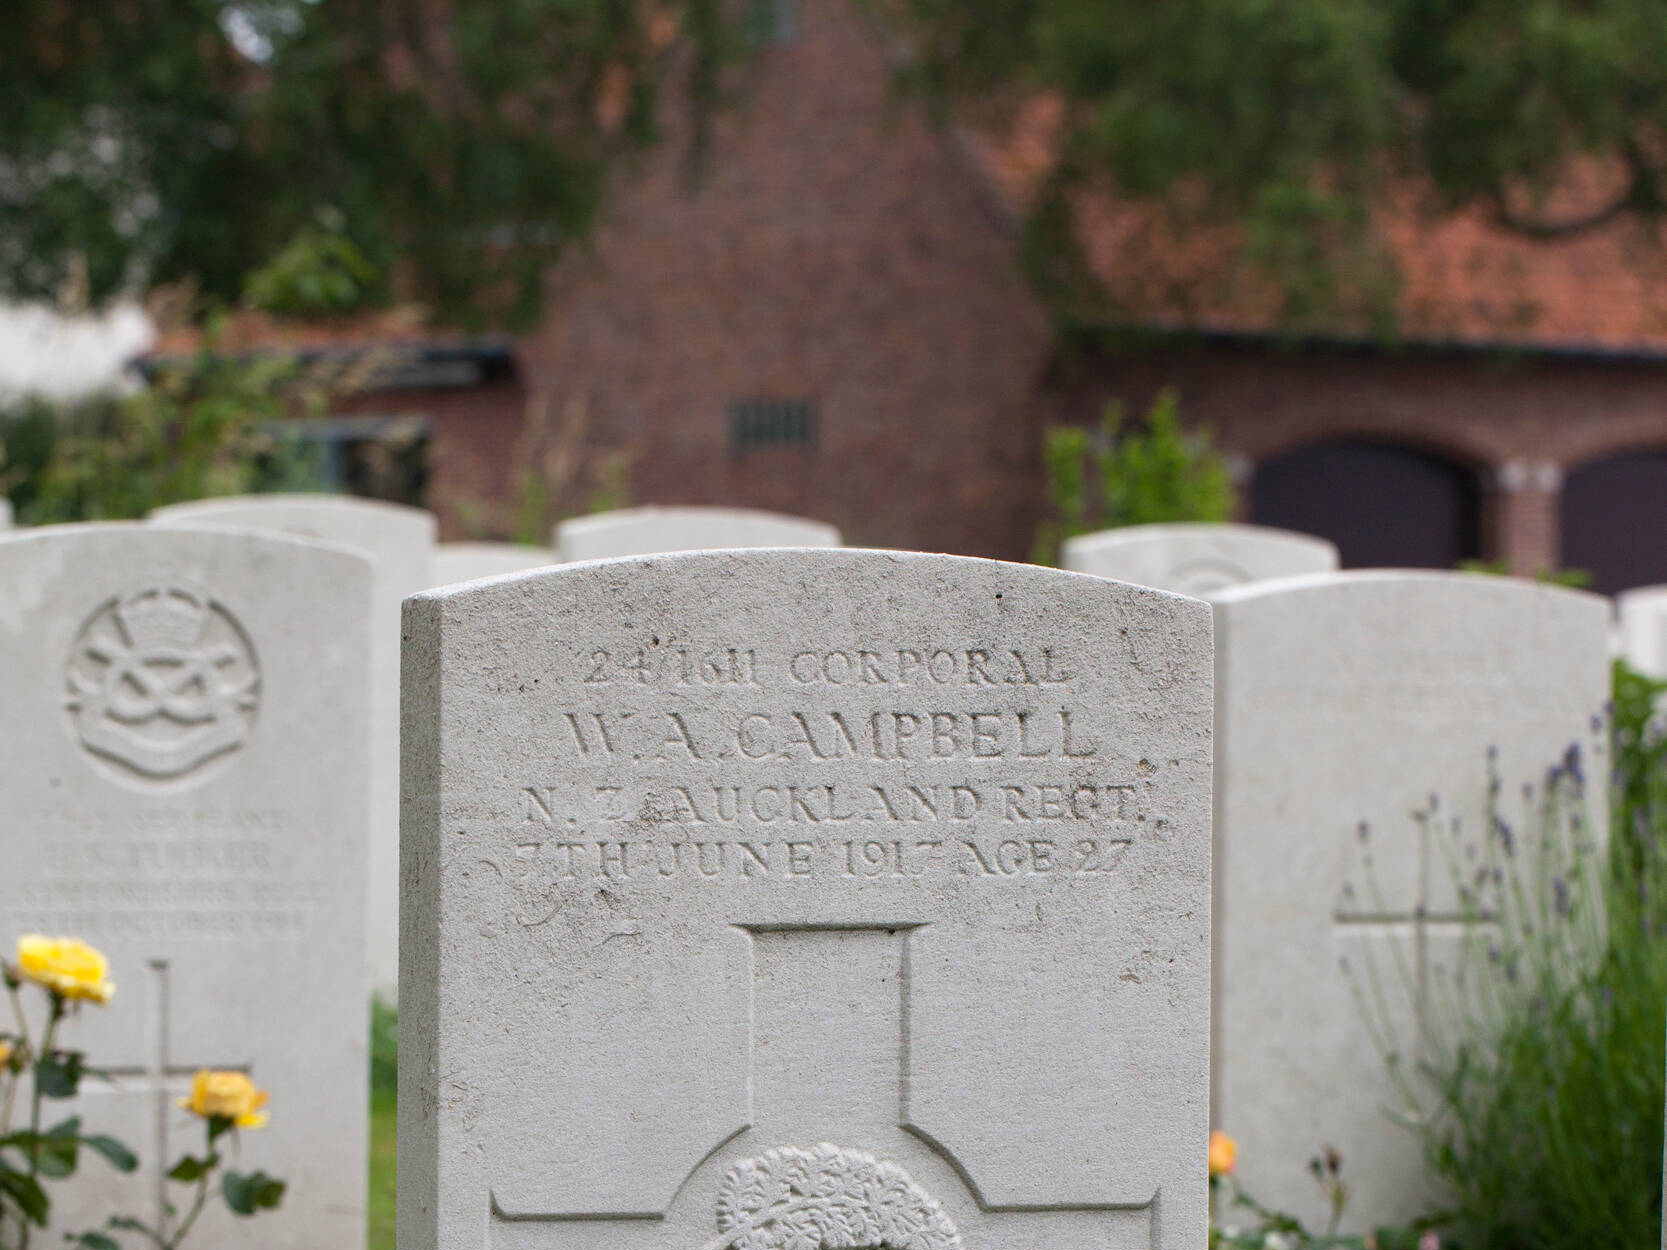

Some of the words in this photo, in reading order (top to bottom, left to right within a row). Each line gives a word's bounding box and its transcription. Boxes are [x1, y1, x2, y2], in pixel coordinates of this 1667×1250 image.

[789, 647, 1075, 687] CORPORAL
[659, 783, 981, 823] AUCKLAND
[515, 840, 632, 879] 7TH
[654, 839, 816, 879] JUNE
[841, 839, 943, 877] 1917
[957, 838, 1054, 876] AGE
[1072, 838, 1133, 874] 27
